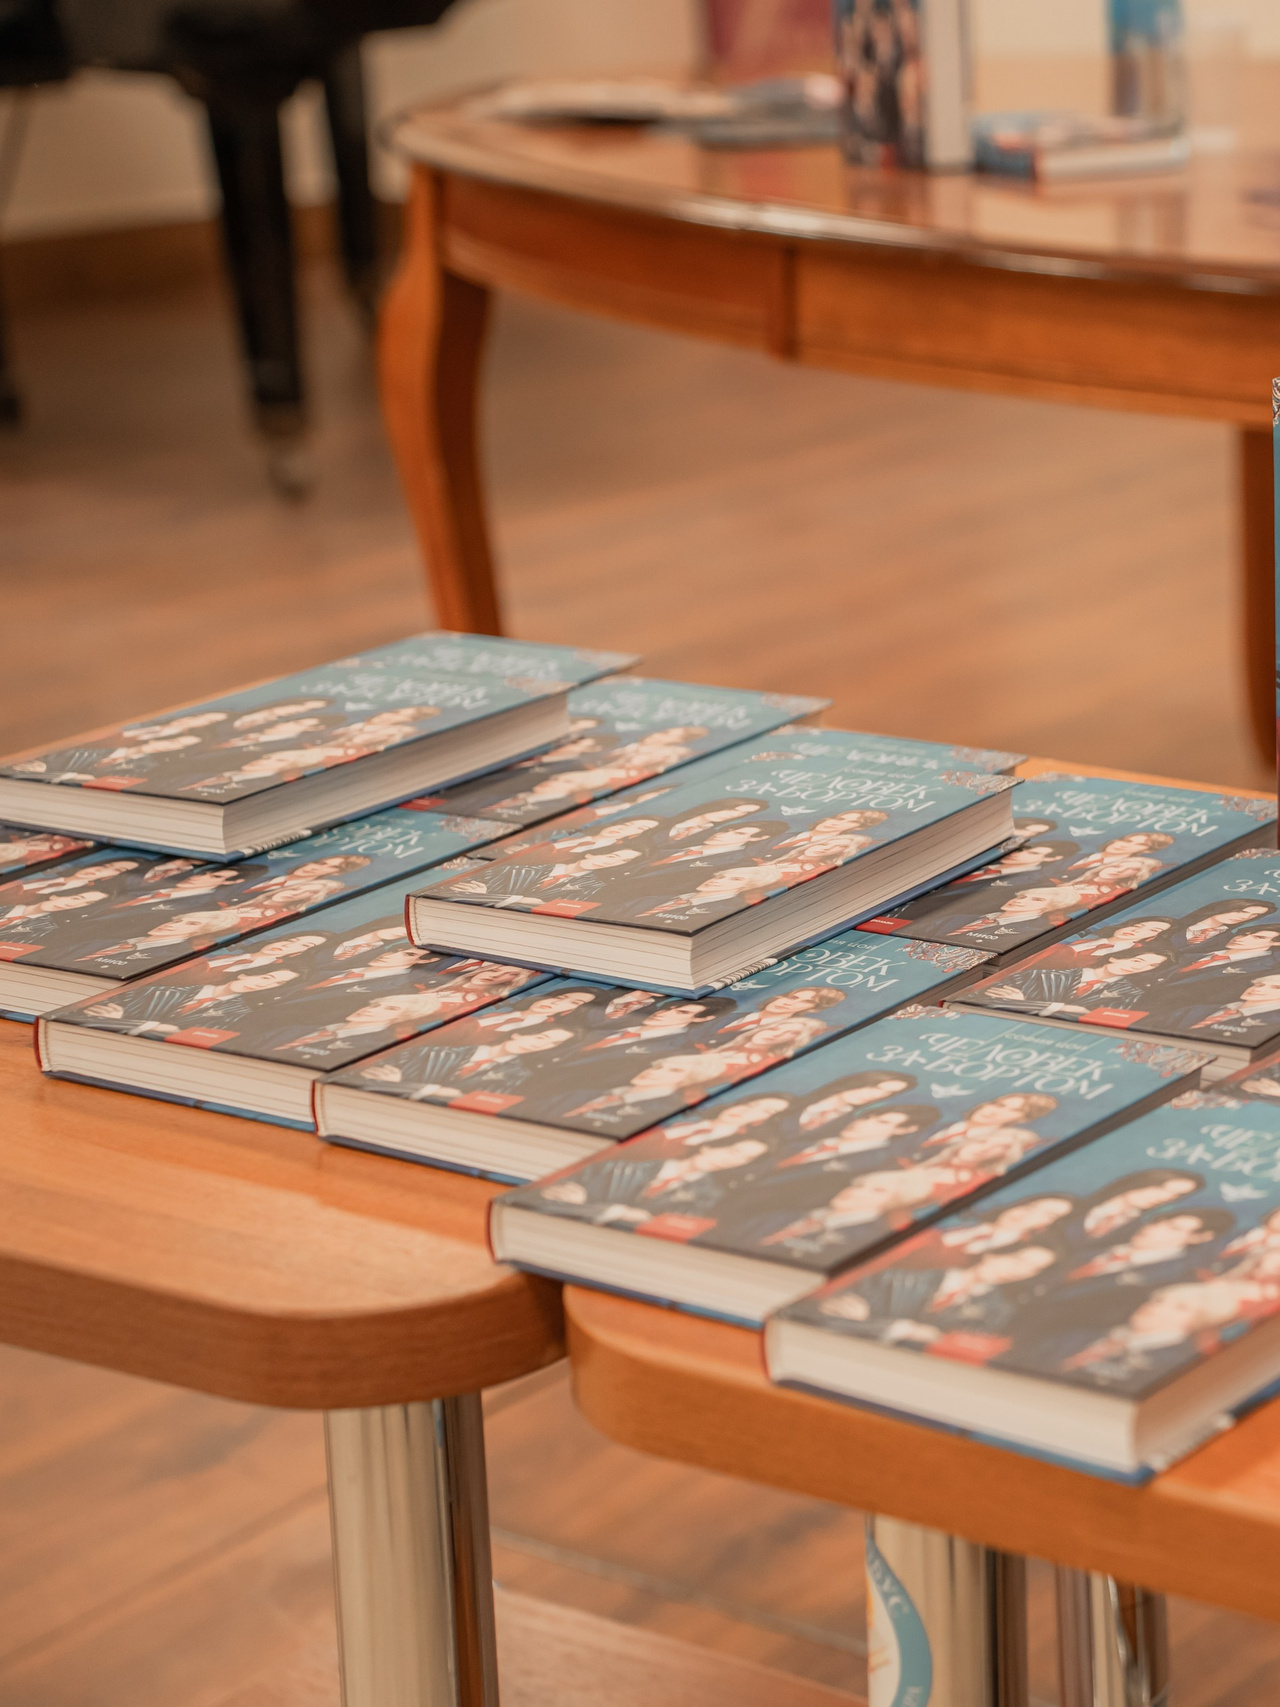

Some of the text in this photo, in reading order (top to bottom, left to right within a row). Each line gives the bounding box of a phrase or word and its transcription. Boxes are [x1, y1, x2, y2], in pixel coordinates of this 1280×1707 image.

[1223, 879, 1279, 896] ЗА
[761, 960, 900, 992] РТОМ
[791, 948, 908, 976] ОВЕК
[918, 1032, 1121, 1083] ЧЕЛОВЕК
[923, 1056, 1115, 1101] БОРТОМ
